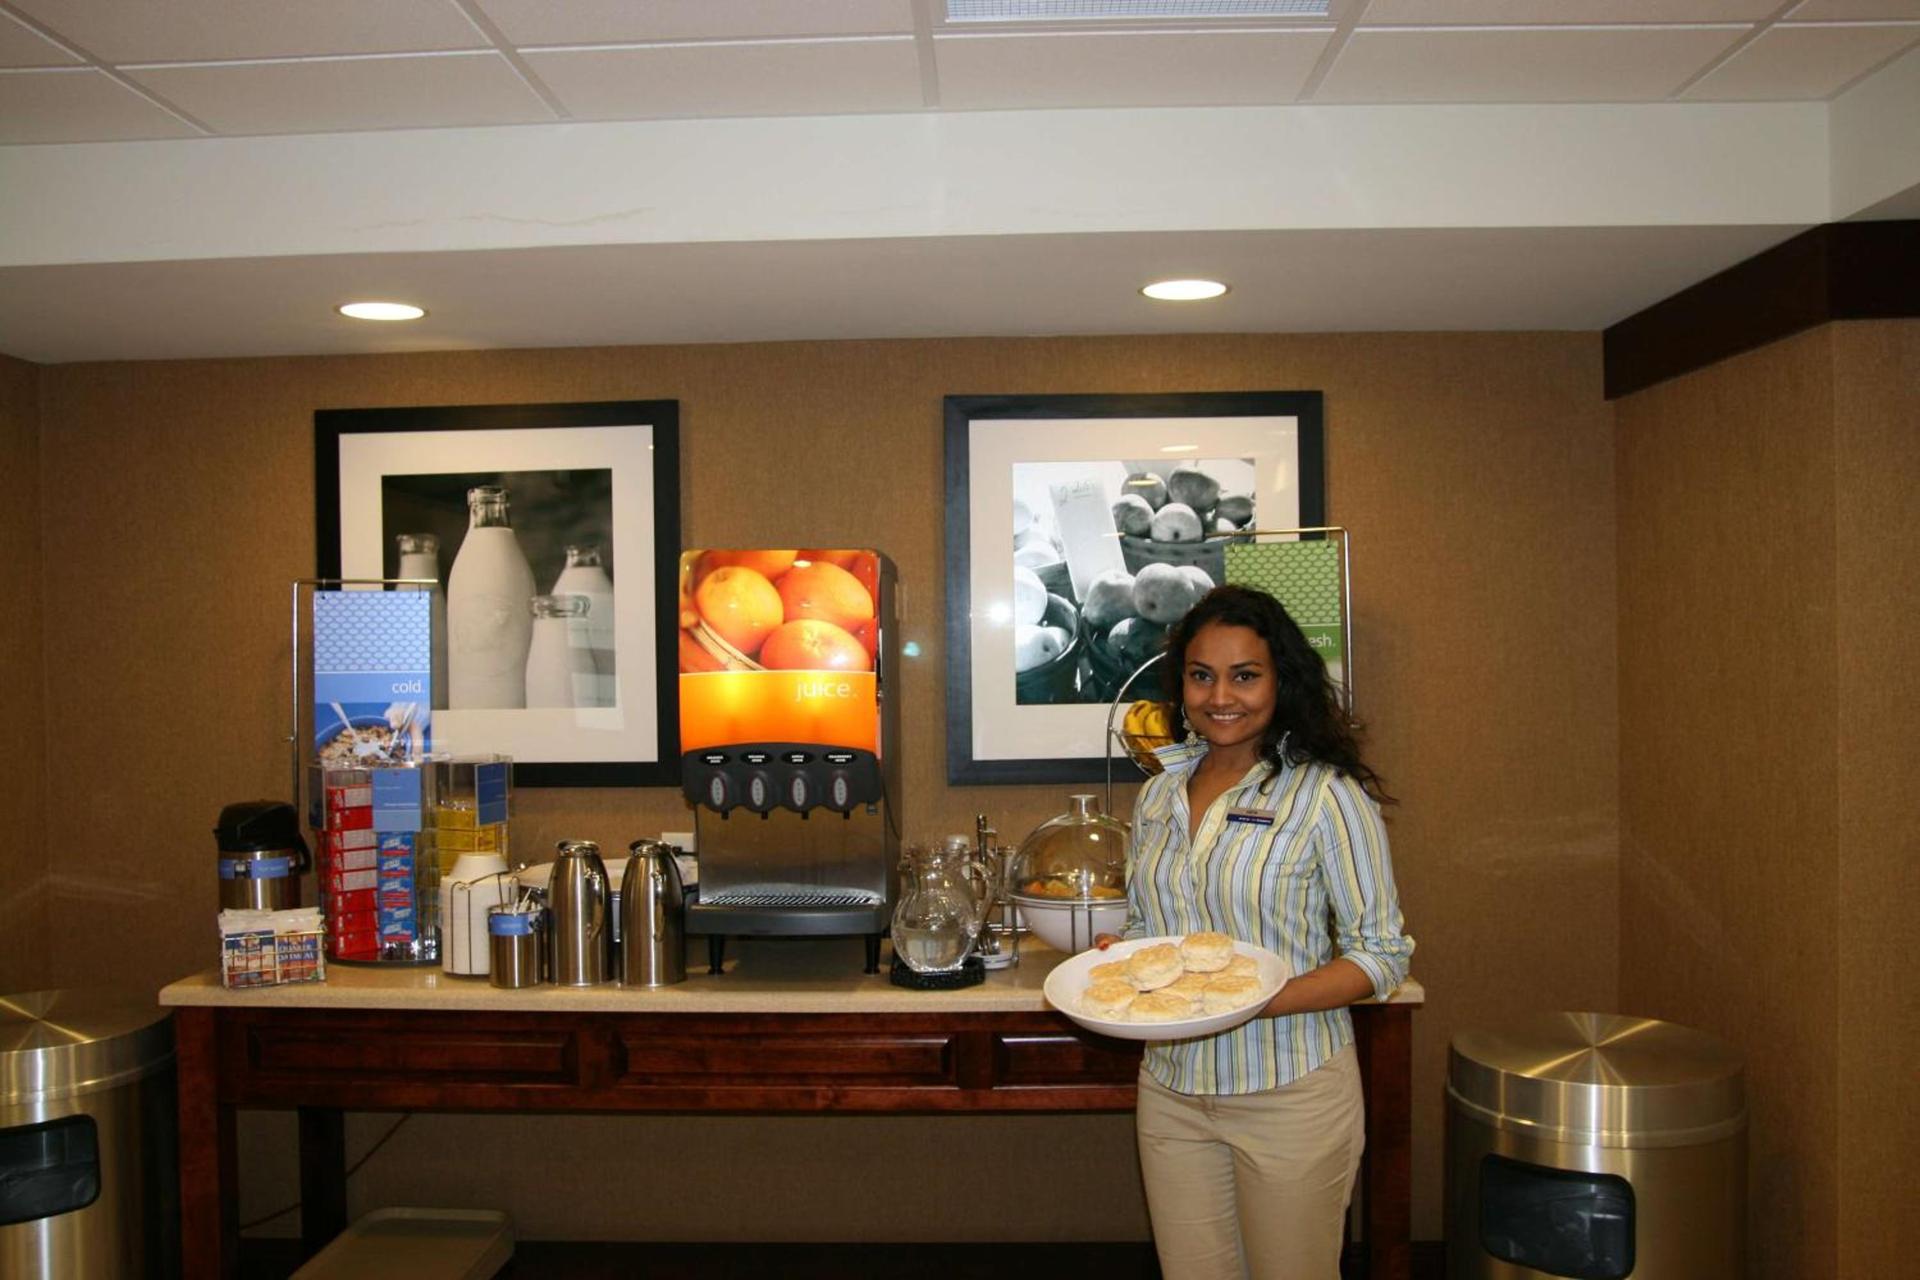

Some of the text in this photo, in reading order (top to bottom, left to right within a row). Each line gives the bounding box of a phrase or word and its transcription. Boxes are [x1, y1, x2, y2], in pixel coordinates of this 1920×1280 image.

[1308, 633, 1336, 647] esh.
[392, 679, 425, 694] cold.
[796, 680, 858, 702] juice.
